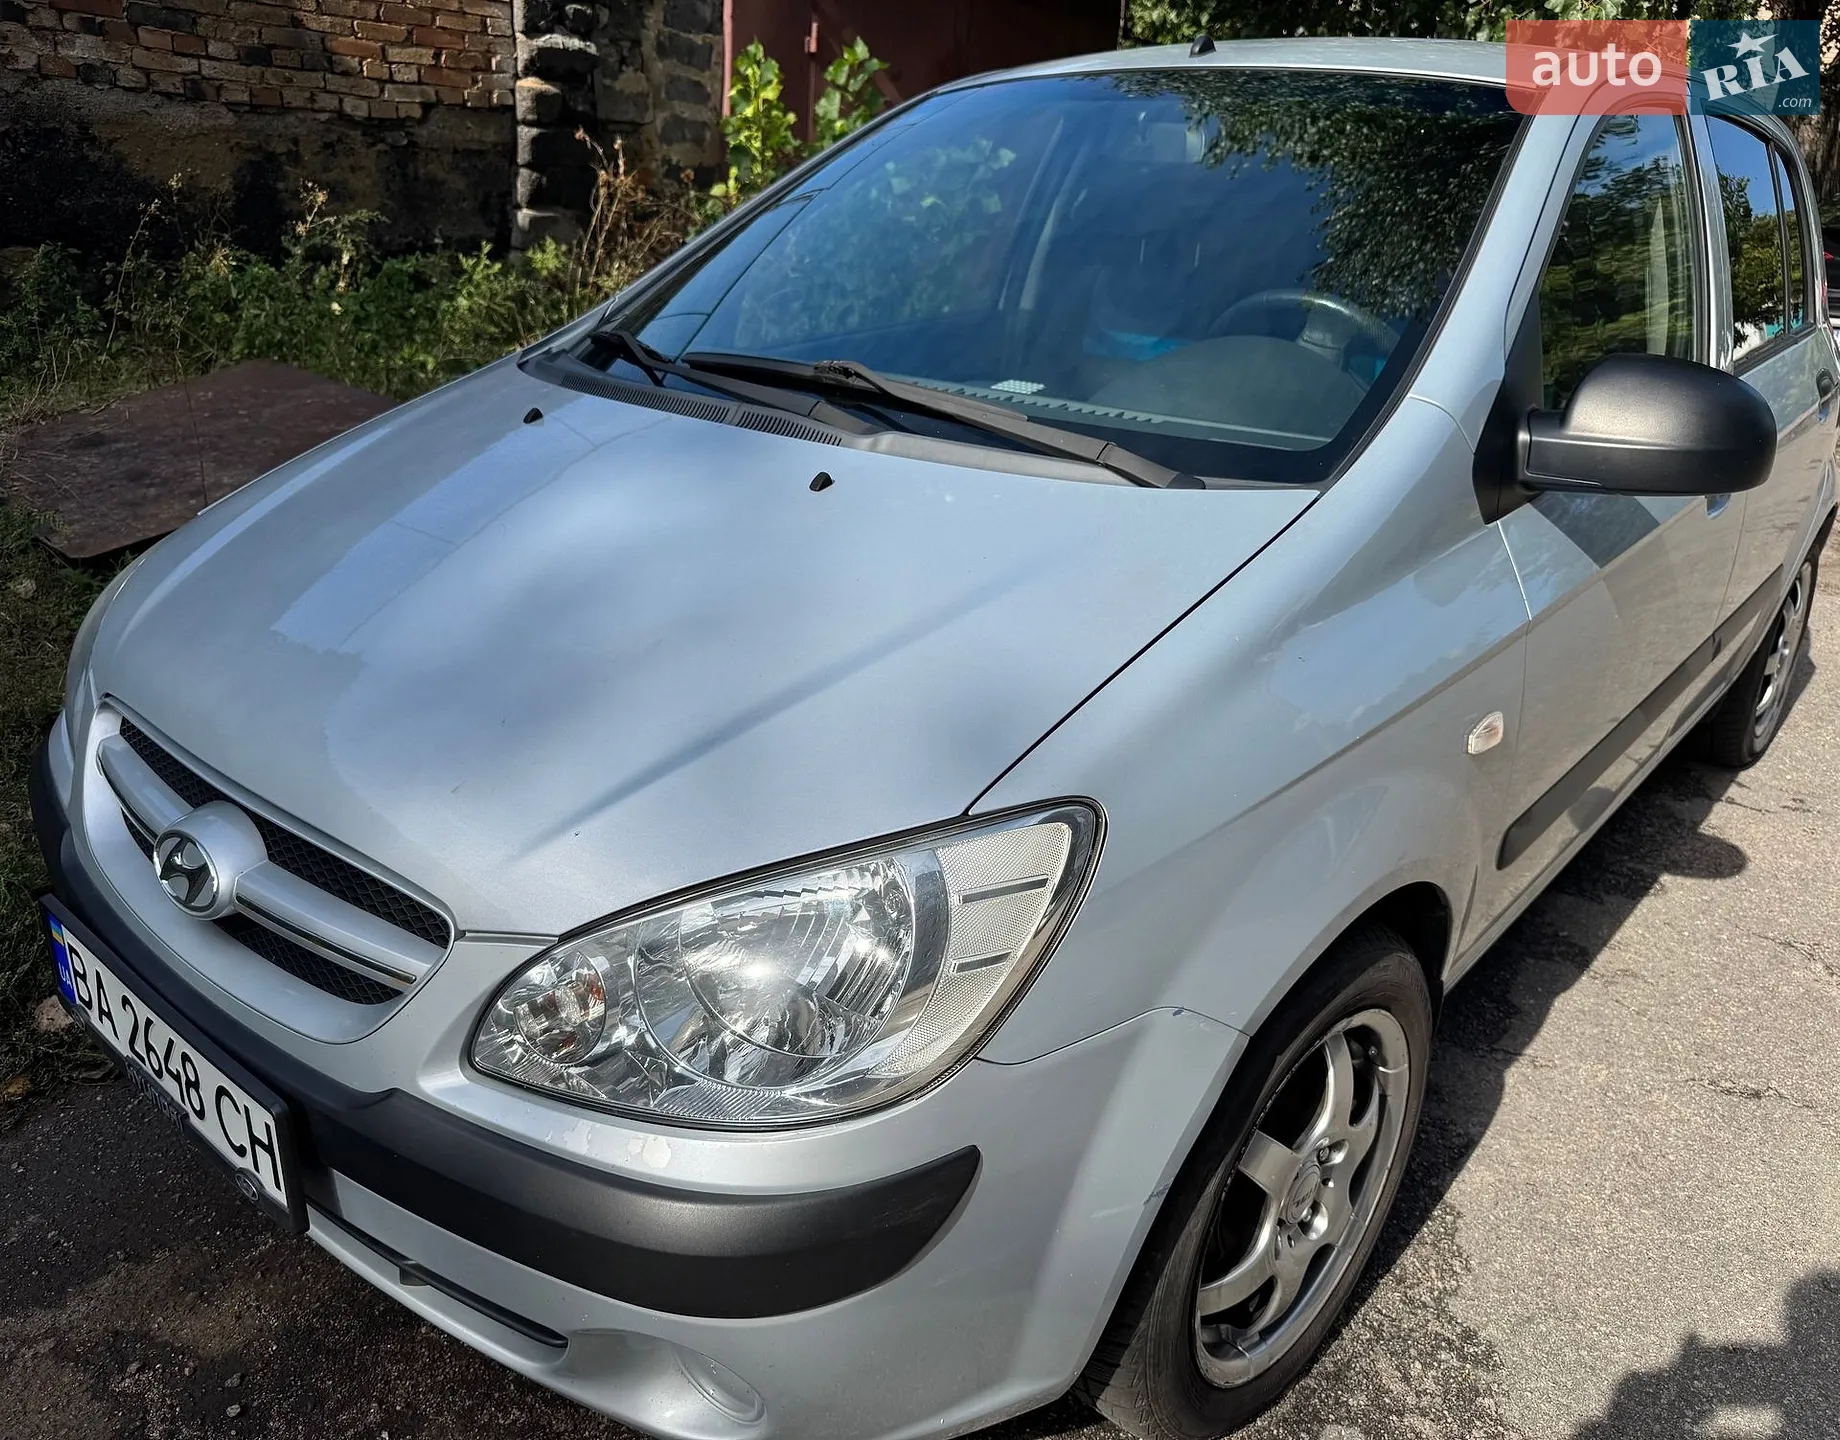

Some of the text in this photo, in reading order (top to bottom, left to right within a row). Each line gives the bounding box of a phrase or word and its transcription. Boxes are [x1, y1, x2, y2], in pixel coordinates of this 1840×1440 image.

[58, 961, 73, 990] UA
[66, 940, 283, 1192] BA 2648 CH
